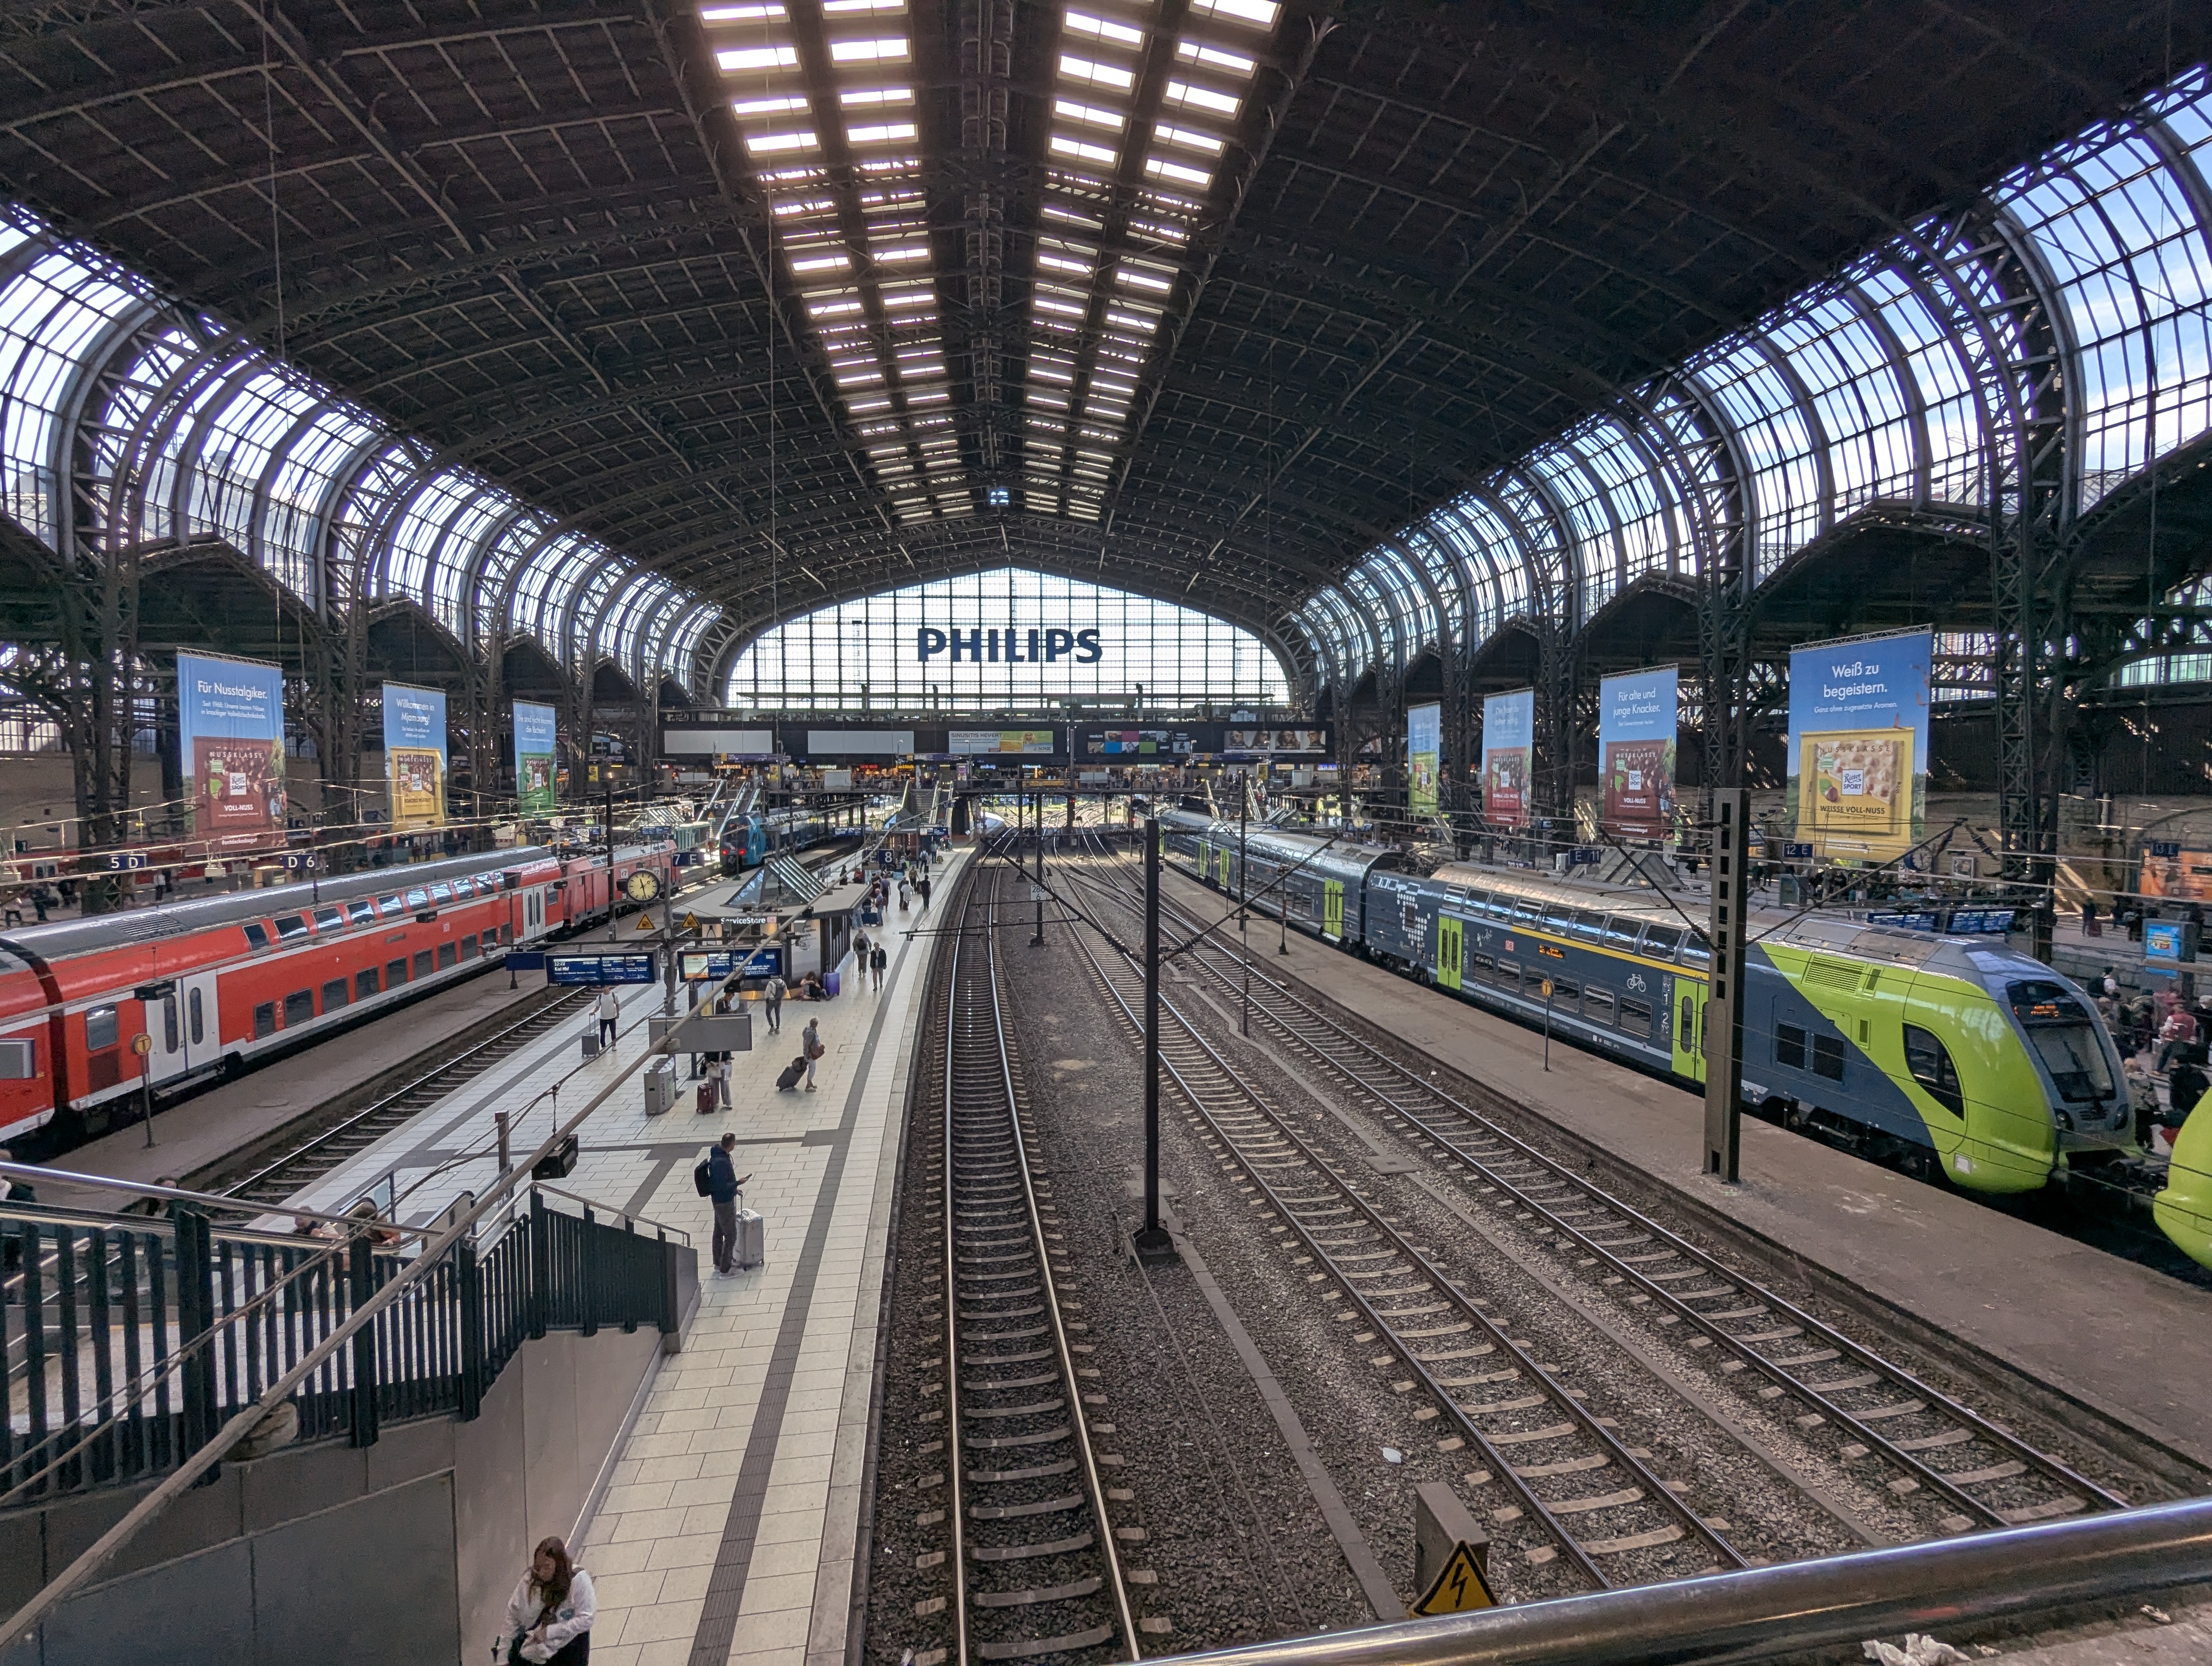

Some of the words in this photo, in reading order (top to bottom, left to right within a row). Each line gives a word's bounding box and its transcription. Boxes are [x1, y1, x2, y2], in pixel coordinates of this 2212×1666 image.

[918, 628, 1102, 663] PHILIPS
[1832, 661, 1862, 678] Weiß
[1865, 664, 1879, 675] zu
[197, 680, 212, 693] Für
[214, 682, 267, 701] Nusstalgiker.
[1618, 691, 1628, 701] Für
[1629, 689, 1641, 700] alte
[1643, 686, 1656, 699] und
[1824, 683, 1887, 700] begeistern.
[396, 698, 428, 710] Willkommen
[430, 703, 434, 711] in
[1613, 707, 1630, 719] junge
[1632, 702, 1661, 714] Knacker.
[1819, 745, 1891, 753] NUSSKLASSE
[1844, 773, 1862, 784] Ritter
[1786, 844, 1796, 855] 12
[1802, 844, 1808, 855] E
[673, 854, 679, 865] 7
[690, 854, 698, 864] E
[885, 851, 892, 863] 8
[1575, 851, 1582, 861] E
[1590, 850, 1599, 861] 11
[111, 857, 120, 868] 5
[129, 857, 138, 868] D
[288, 856, 298, 867] D
[306, 856, 314, 867] 6
[1663, 994, 1668, 1004] 1
[277, 1001, 282, 1012] 2
[1662, 1013, 1668, 1024] 2
